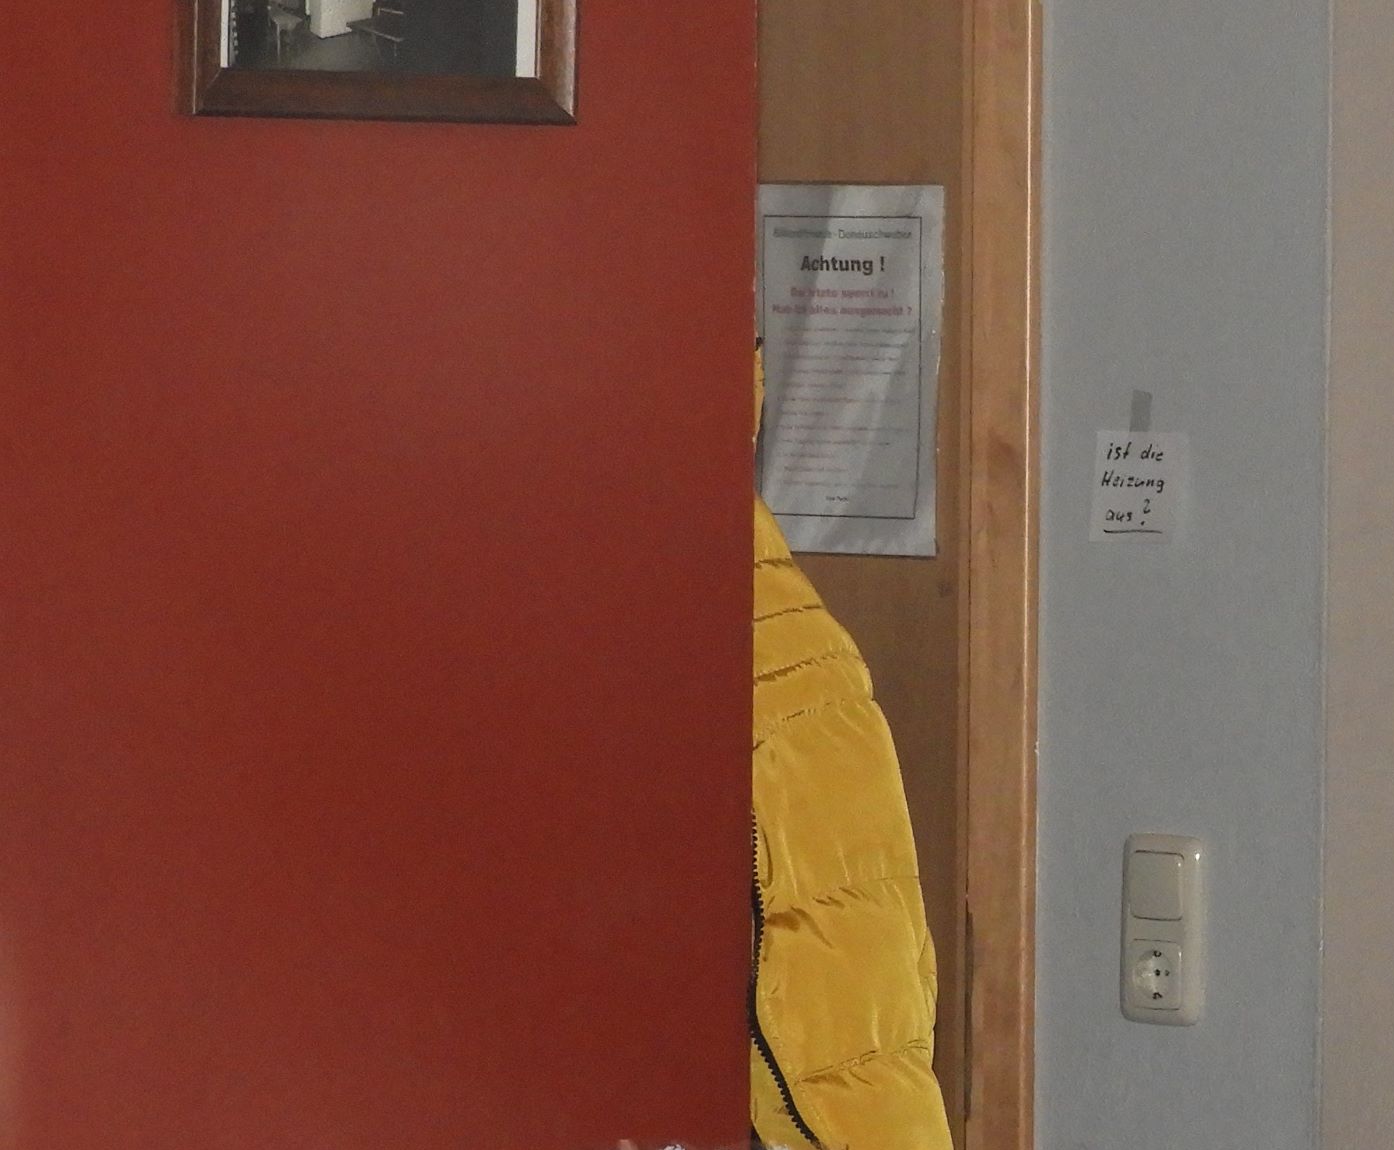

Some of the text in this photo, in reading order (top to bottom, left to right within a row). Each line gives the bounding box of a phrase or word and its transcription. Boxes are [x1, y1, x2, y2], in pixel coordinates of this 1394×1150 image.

[800, 255, 886, 276] Achtung !
[1106, 441, 1165, 462] ist die
[1101, 470, 1166, 494] Heizung
